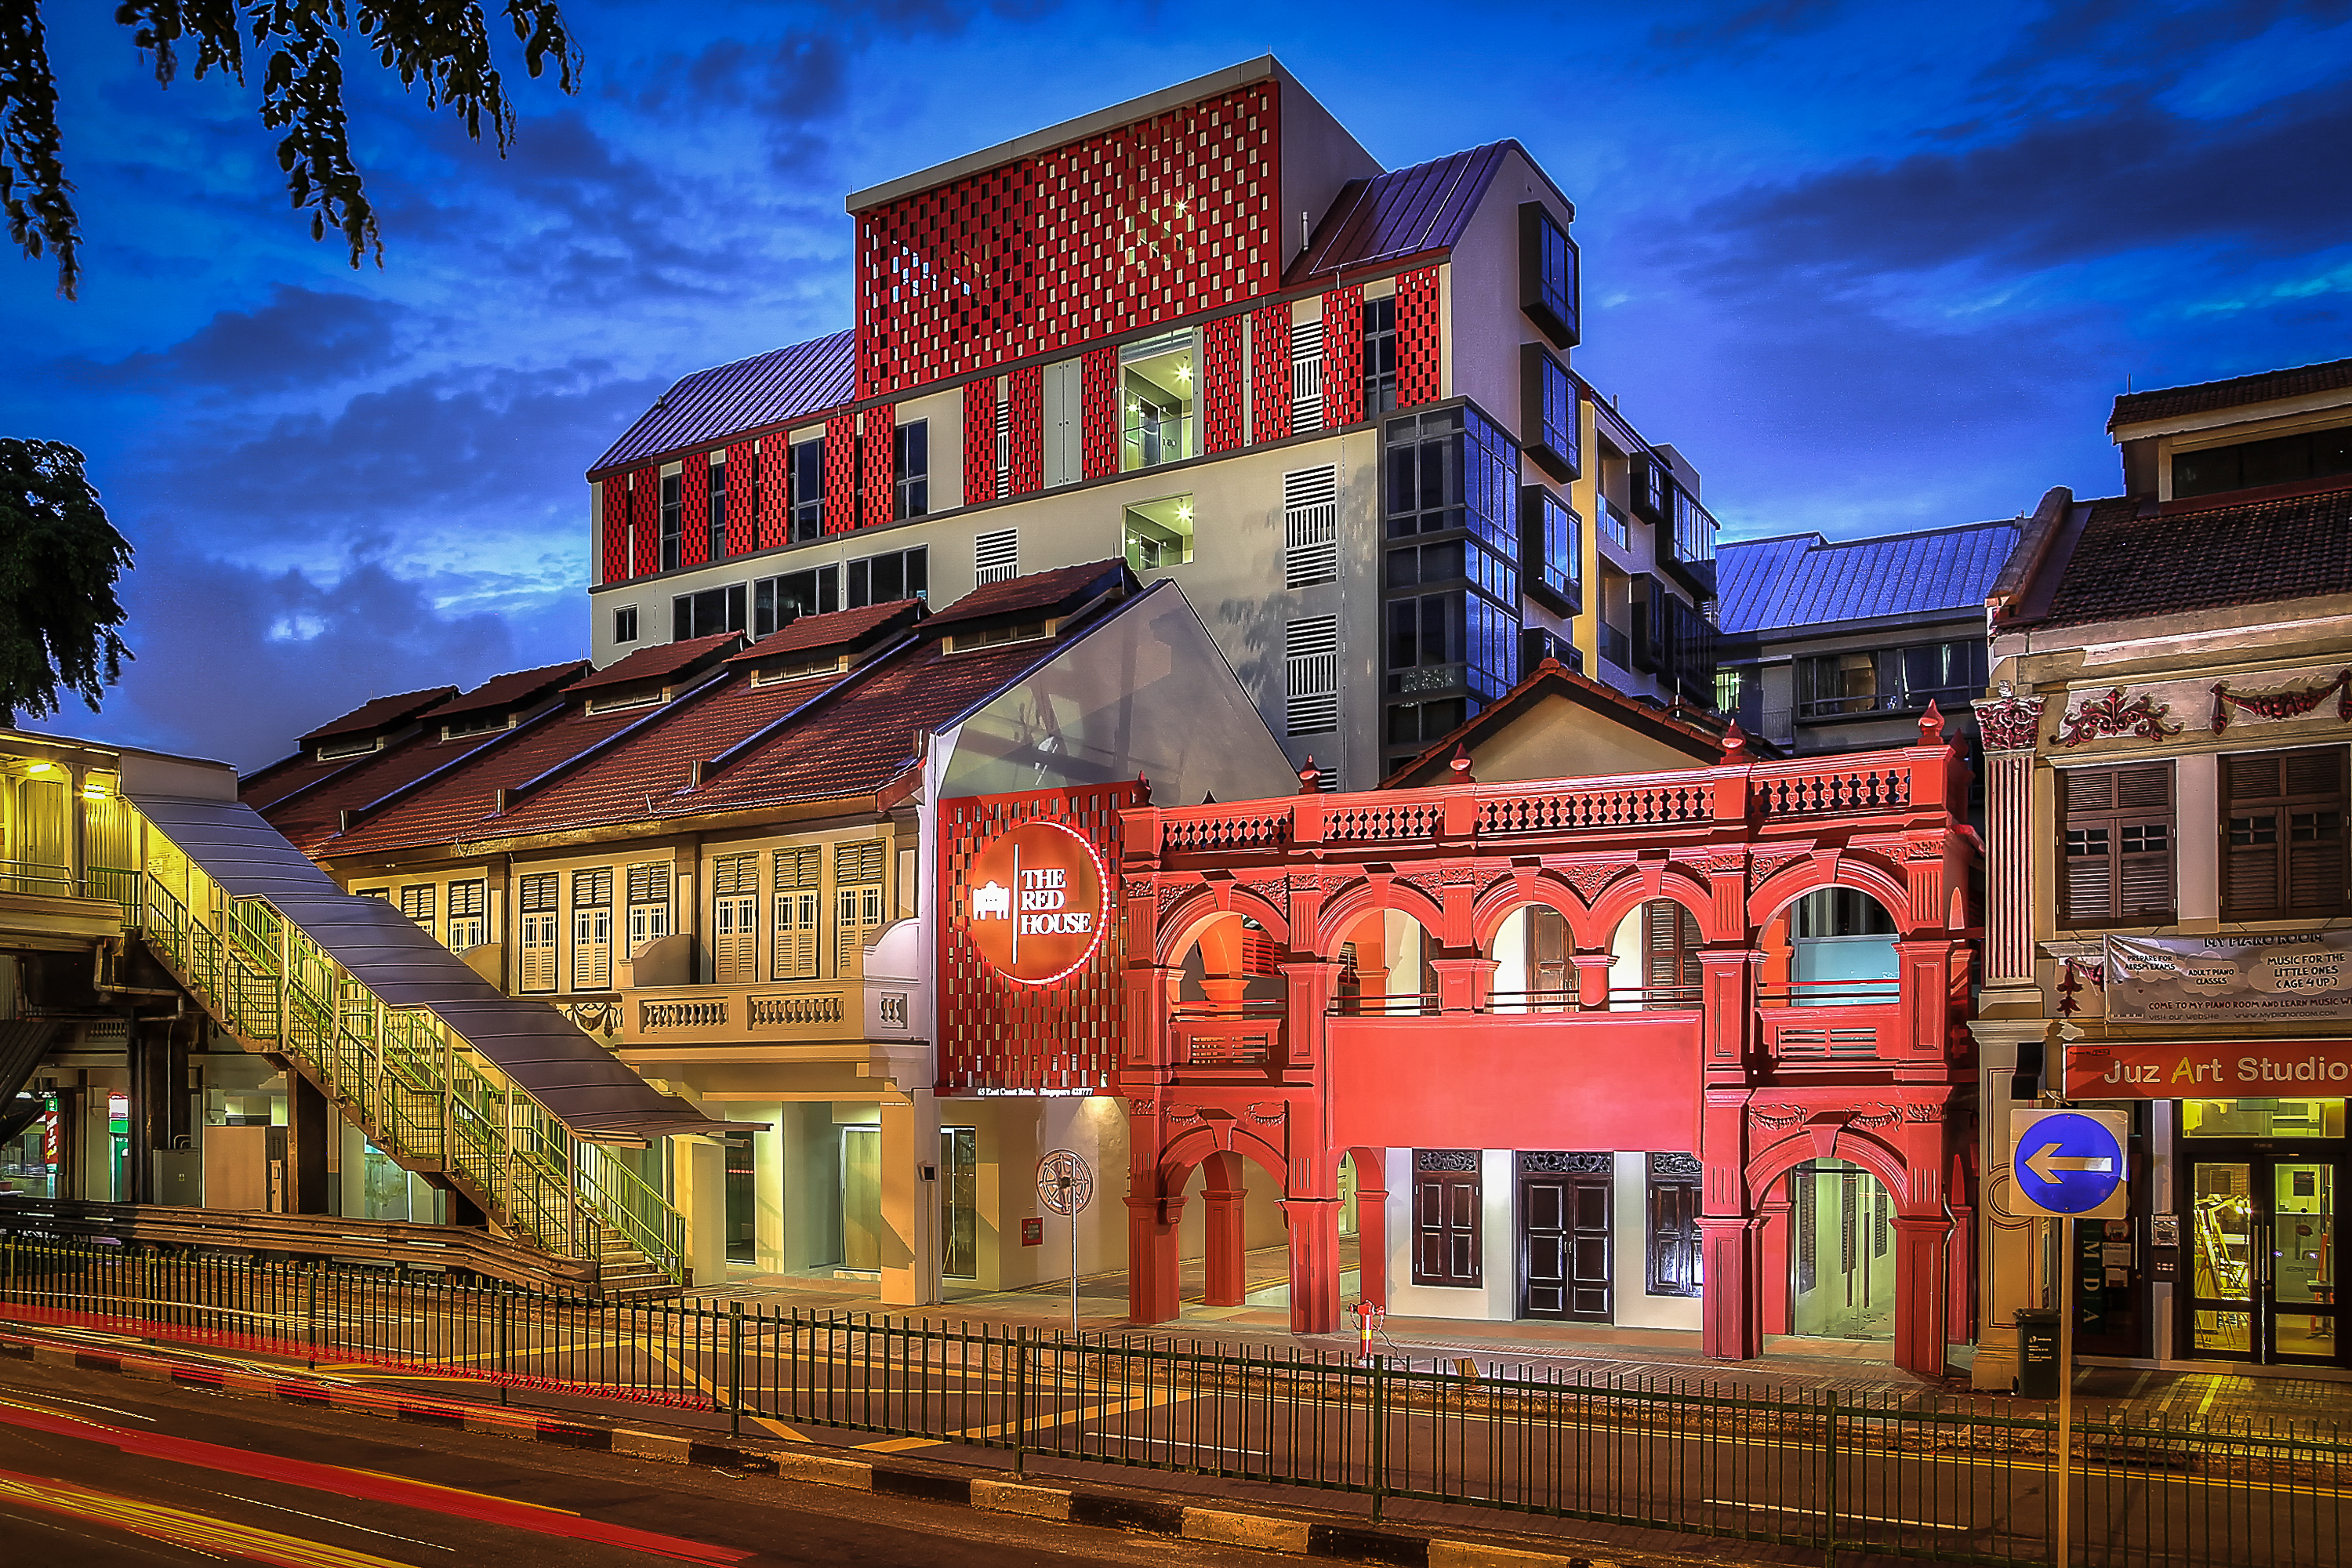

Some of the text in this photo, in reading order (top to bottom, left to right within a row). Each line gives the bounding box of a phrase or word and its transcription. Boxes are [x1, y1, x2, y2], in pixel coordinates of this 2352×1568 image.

[1020, 869, 1067, 889] THE
[1020, 890, 1065, 911] RED
[1020, 913, 1092, 935] HOUSE
[2229, 935, 2274, 946] PIANO
[2267, 953, 2346, 966] MUSIC FOR THE
[2274, 965, 2339, 978] LITTLE ONES
[2195, 977, 2227, 985] CLASSES
[2305, 978, 2314, 987] 4
[2233, 1000, 2260, 1009] ROOM
[2261, 1000, 2280, 1008] AND
[2280, 999, 2308, 1008] LEARN
[2309, 997, 2339, 1007] MUSIC
[2103, 1055, 2352, 1084] Juz Art Studio
